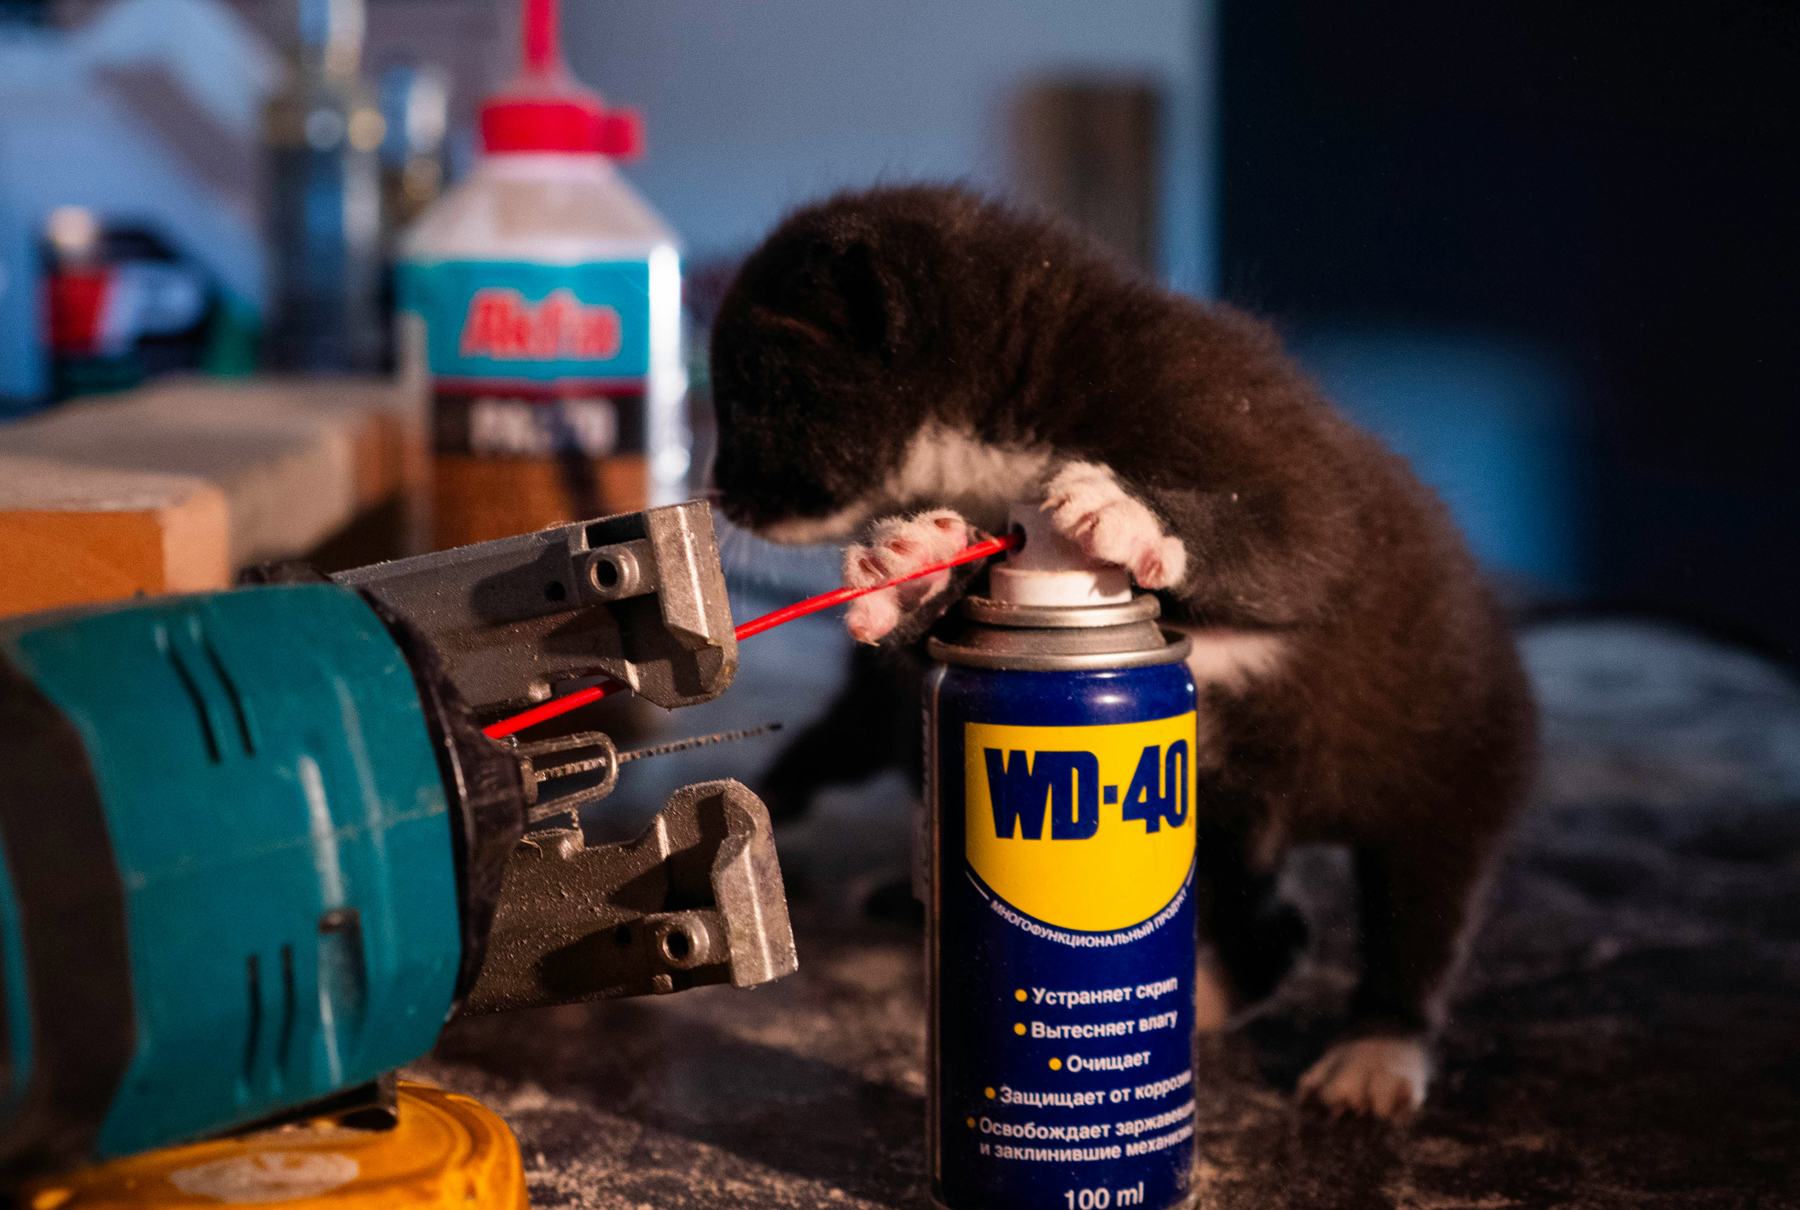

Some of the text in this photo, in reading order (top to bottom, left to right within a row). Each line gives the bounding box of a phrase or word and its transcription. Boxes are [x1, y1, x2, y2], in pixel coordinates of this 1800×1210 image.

[983, 738, 1188, 840] WD-40
[990, 887, 1187, 948] МНОГОФУНКЦИОНАЛЬНЫЙ ПРОДУКТ
[1031, 977, 1178, 1009] Устраняет скрип
[1031, 1010, 1178, 1039] Вытесняет влагу
[1066, 1050, 1152, 1072] Очищает
[1000, 1086, 1106, 1108] Защищает
[1110, 1088, 1132, 1103] от
[979, 1117, 1111, 1142] Освобождает
[980, 1142, 991, 1155] и
[994, 1144, 1122, 1162] заклинившие
[1064, 1181, 1145, 1210] 100 ml
